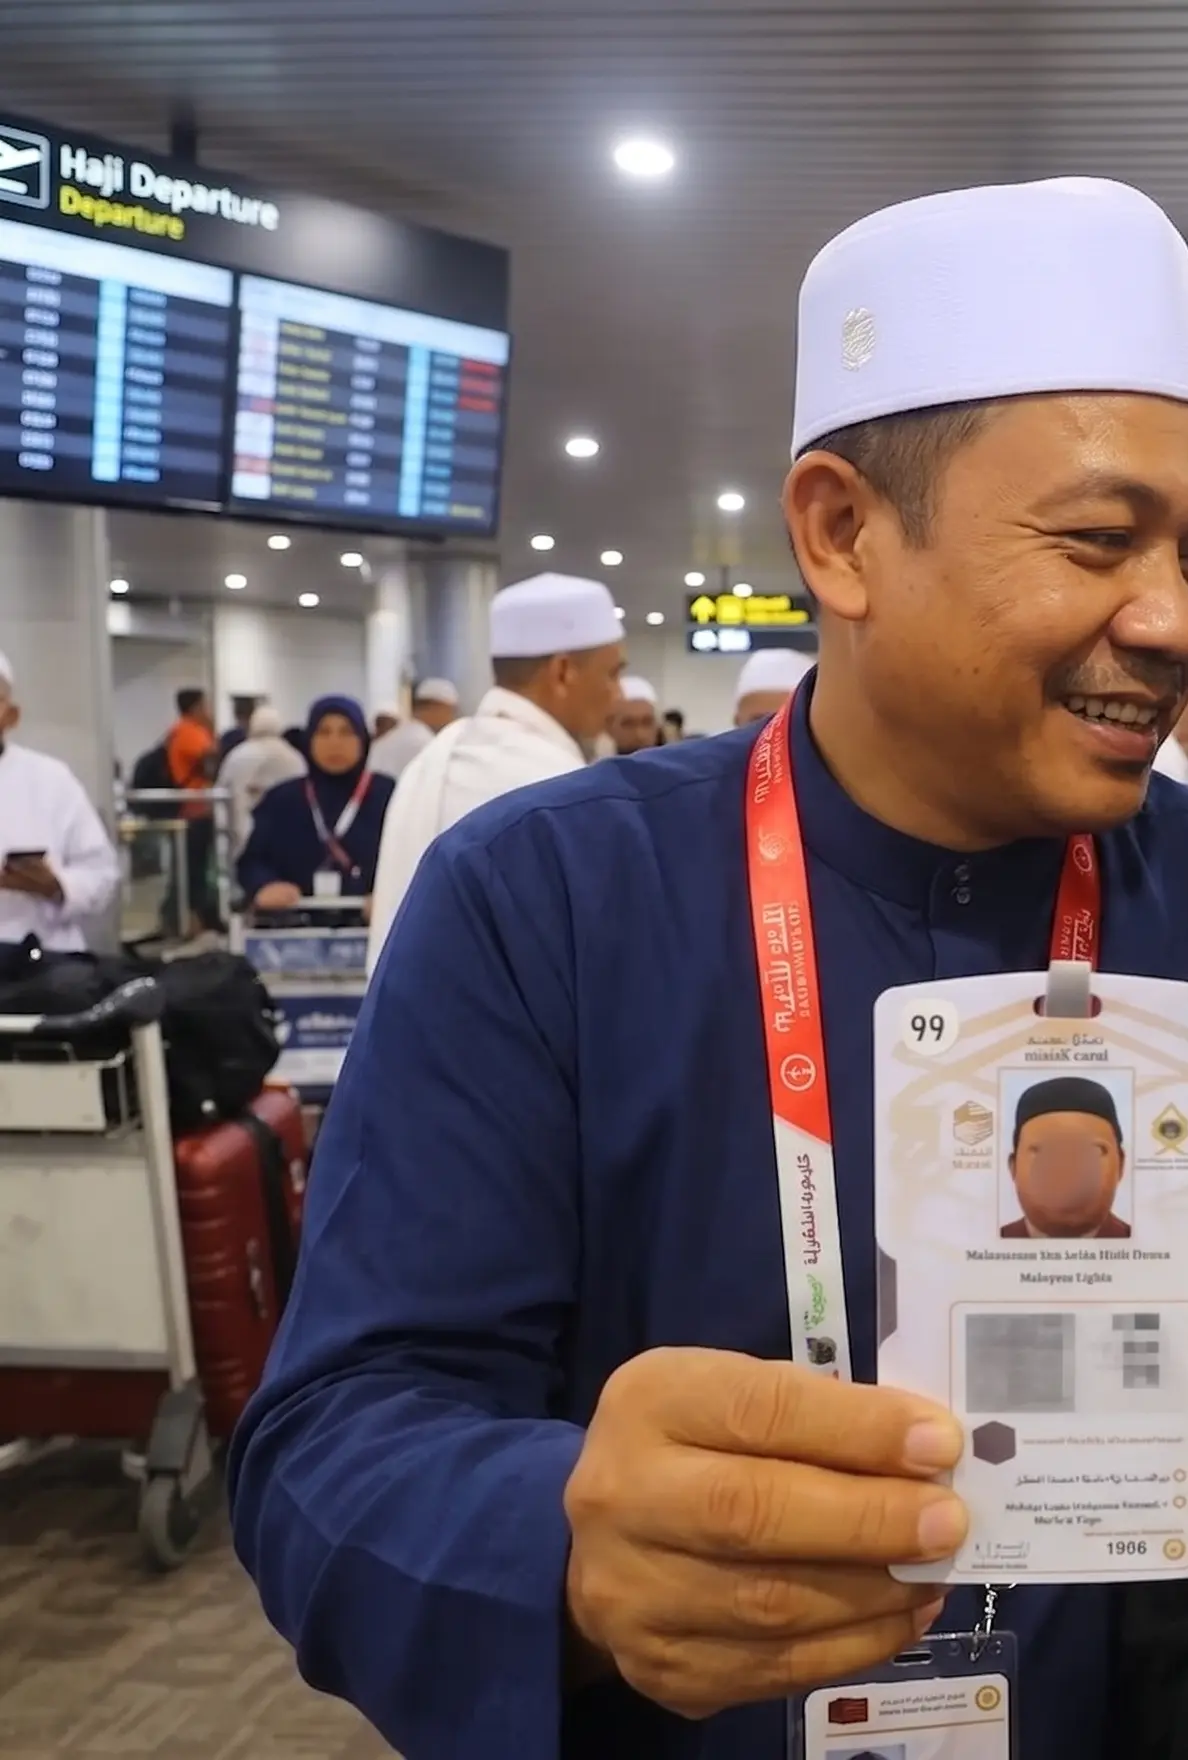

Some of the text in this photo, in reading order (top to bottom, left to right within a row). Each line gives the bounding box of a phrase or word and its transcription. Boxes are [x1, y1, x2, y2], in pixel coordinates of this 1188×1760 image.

[59, 185, 186, 240] Departure
[60, 144, 280, 231] Haji Departure
[911, 1014, 945, 1042] 99
